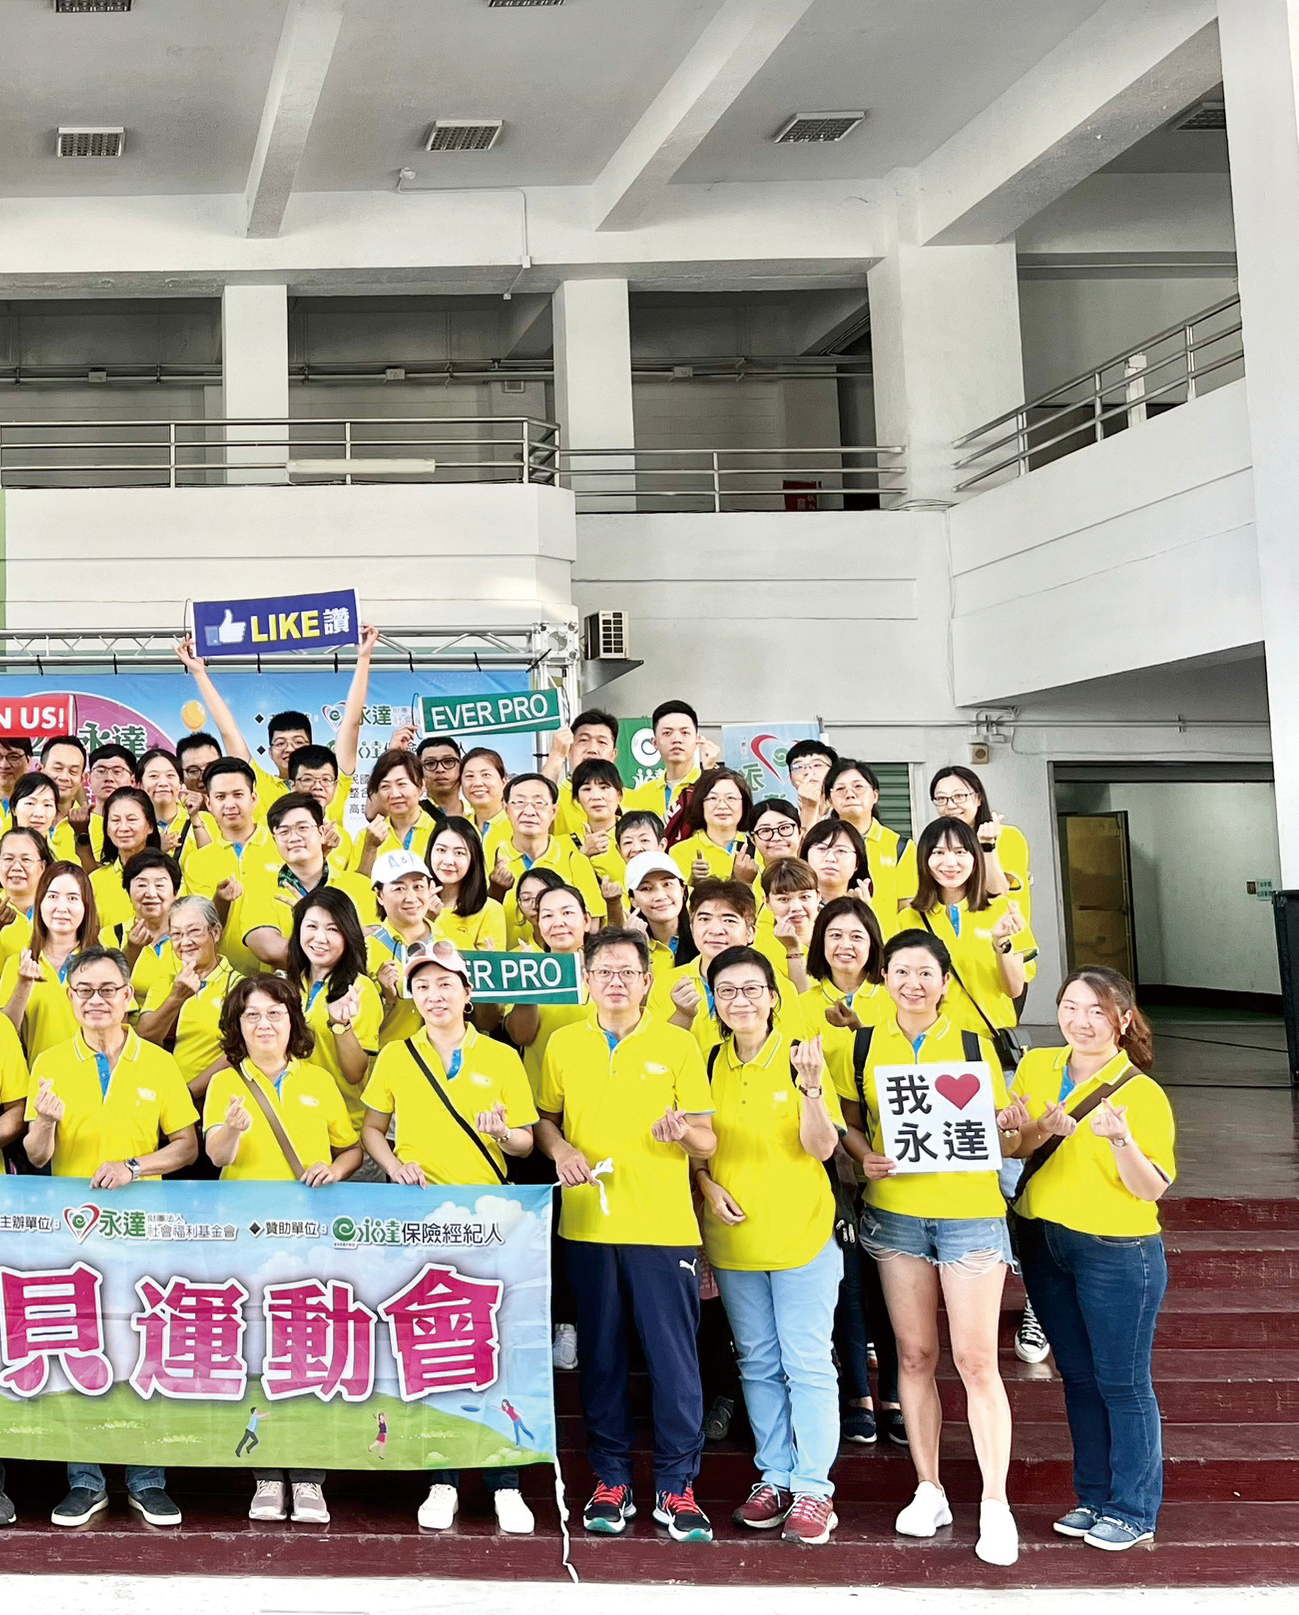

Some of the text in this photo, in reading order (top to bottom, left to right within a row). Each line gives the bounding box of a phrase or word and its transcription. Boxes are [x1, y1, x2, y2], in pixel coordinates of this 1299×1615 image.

[250, 606, 351, 643] LIKE 讚
[19, 706, 66, 730] US!
[430, 700, 496, 731] EVER
[497, 693, 549, 723] PRO
[500, 957, 562, 989] PRO
[885, 1074, 933, 1116] 我
[893, 1119, 990, 1163] 永達
[99, 1209, 147, 1238] 永達
[148, 1224, 237, 1239] 社會福利基金會
